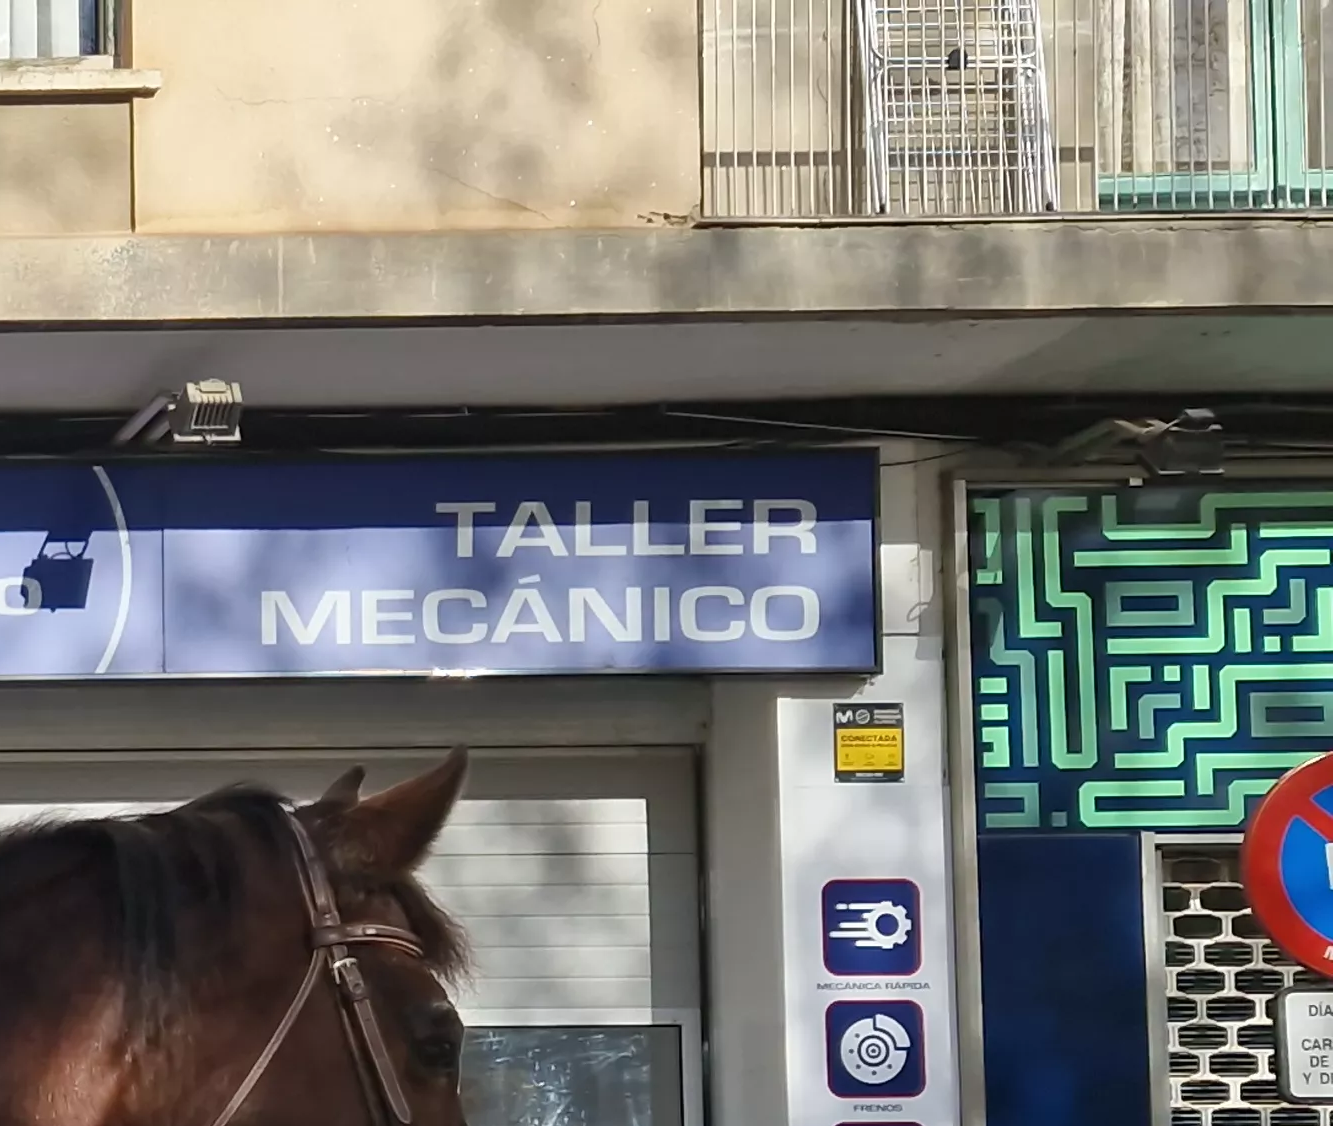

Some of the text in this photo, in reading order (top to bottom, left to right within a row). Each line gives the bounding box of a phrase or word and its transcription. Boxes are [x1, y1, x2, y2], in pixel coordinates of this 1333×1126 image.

[435, 498, 818, 559] TALLER
[260, 573, 821, 646] MECÁNICO
[840, 734, 898, 742] CONECTADA
[816, 981, 882, 990] MECÁNICA
[1309, 1055, 1330, 1068] DE
[1302, 1072, 1312, 1085] Y
[853, 1103, 904, 1113] FRENOS
